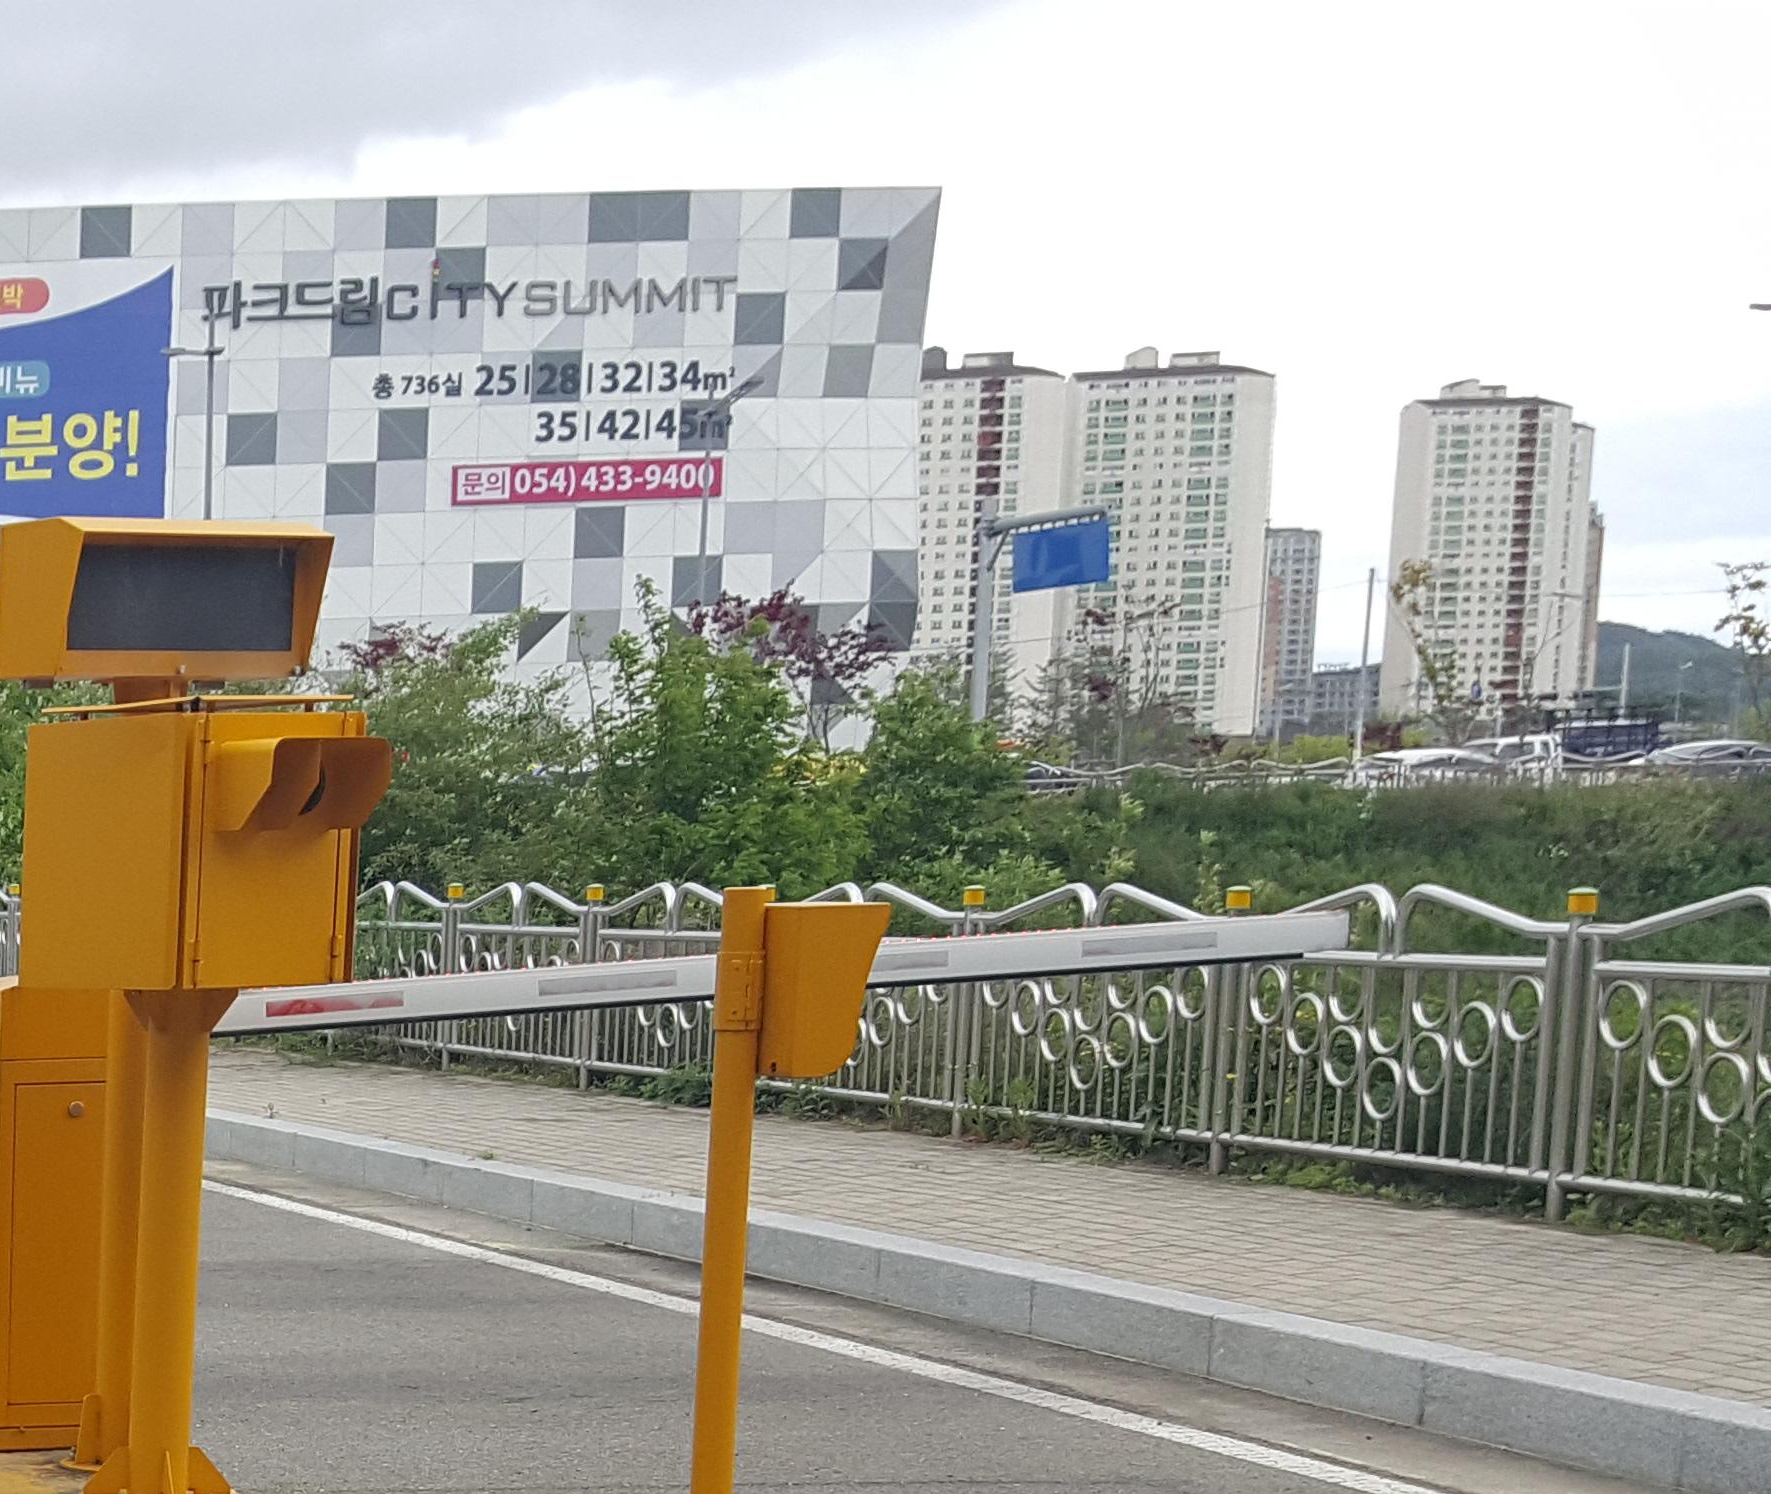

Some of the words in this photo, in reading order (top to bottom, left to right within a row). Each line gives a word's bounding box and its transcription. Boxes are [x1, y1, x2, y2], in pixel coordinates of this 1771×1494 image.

[201, 276, 379, 329] 파크드림
[372, 373, 394, 399] 총
[401, 372, 463, 397] 736실
[461, 470, 506, 496] 문의
